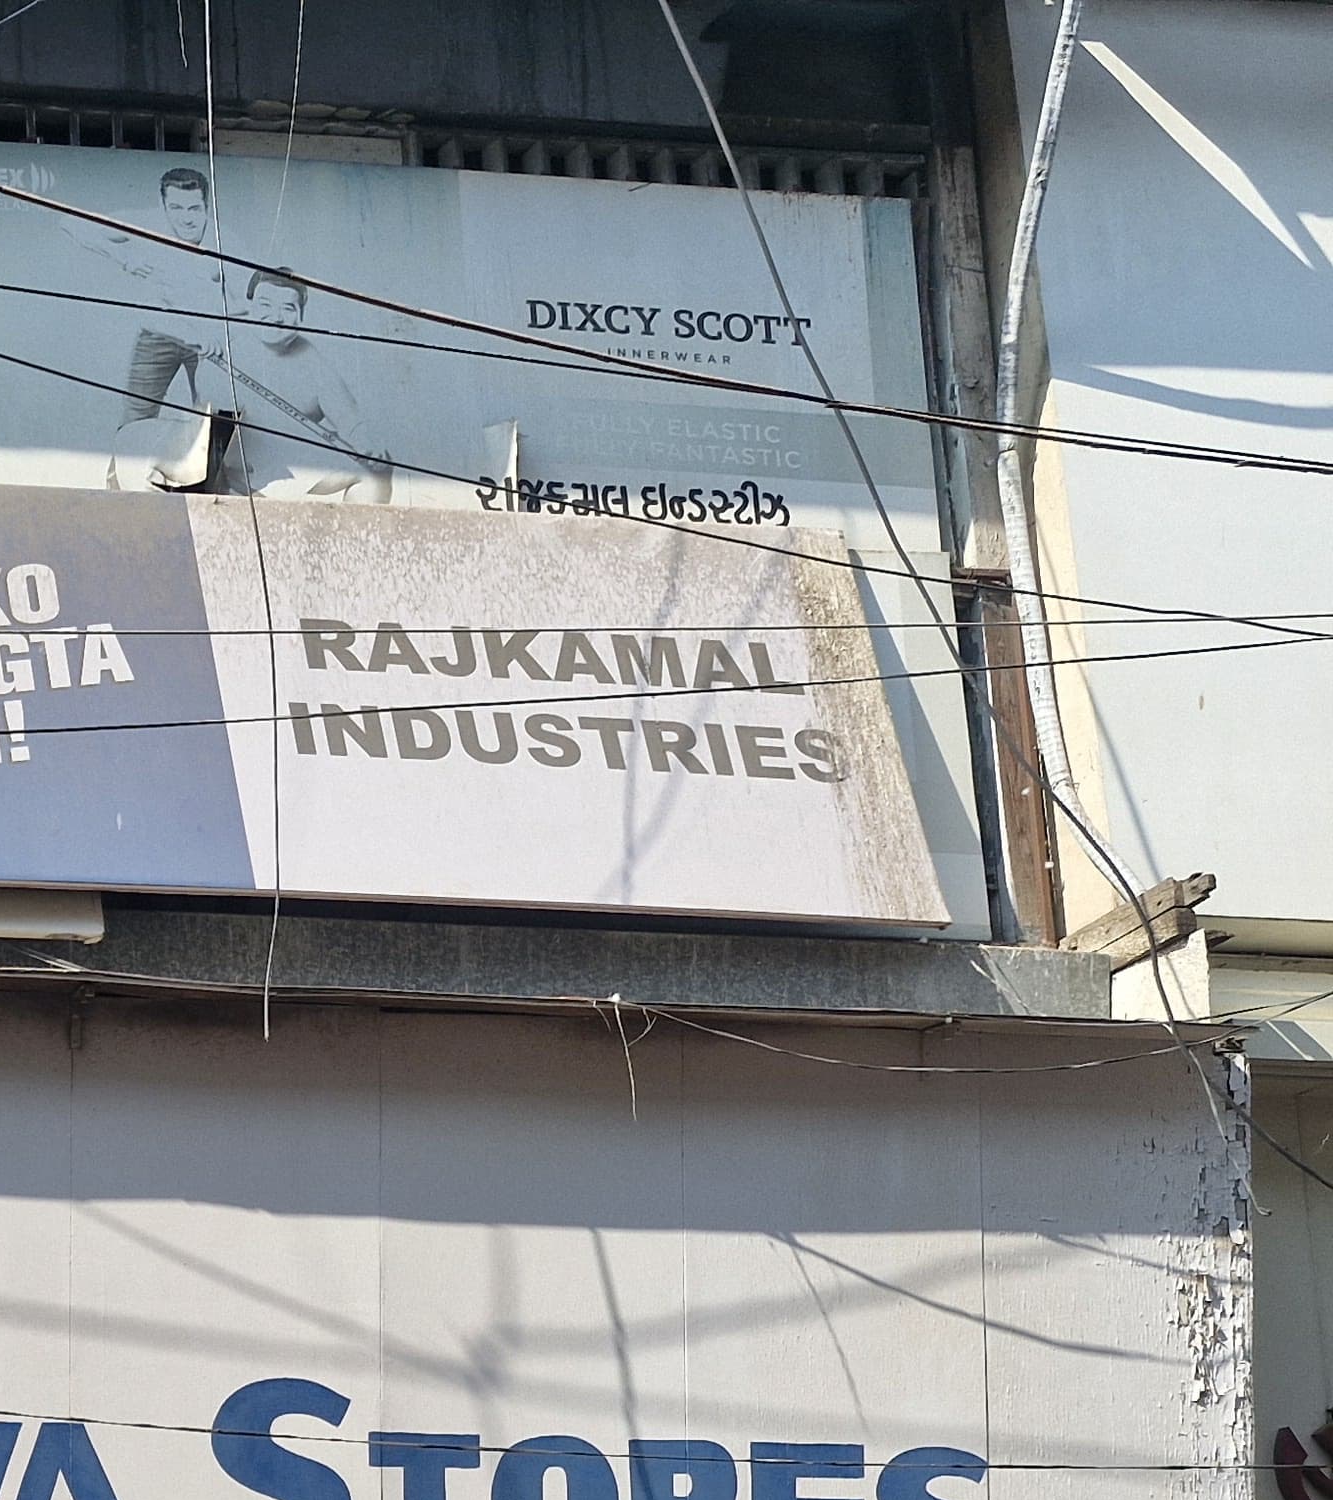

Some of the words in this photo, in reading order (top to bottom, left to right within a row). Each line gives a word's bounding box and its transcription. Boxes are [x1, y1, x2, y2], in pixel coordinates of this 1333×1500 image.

[526, 299, 661, 337] DIXCY
[674, 308, 812, 347] SCOTT
[606, 347, 732, 365] INNERWEAR
[668, 419, 782, 444] ELASTIC
[297, 616, 810, 698] RAJKAMAL
[290, 700, 849, 785] INDUSTRIES
